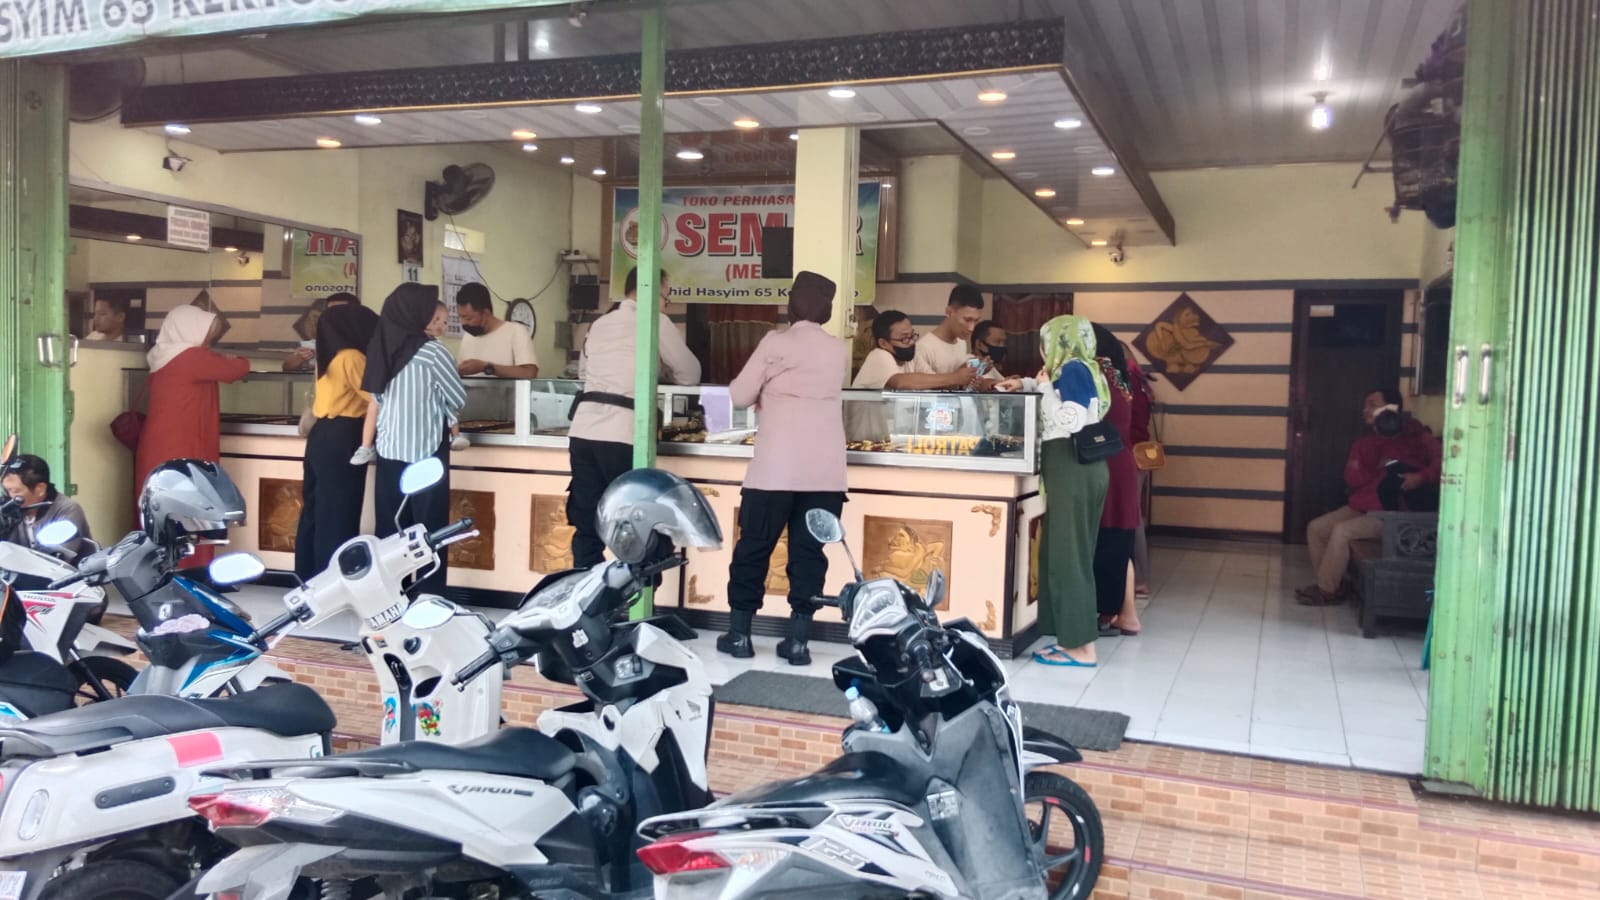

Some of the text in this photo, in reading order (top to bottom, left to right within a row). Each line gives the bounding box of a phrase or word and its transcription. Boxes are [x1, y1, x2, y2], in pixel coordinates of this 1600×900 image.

[682, 196, 718, 206] TOKO
[696, 288, 750, 299] Hasyim
[754, 288, 773, 297] 65
[366, 602, 404, 629] AMAH
